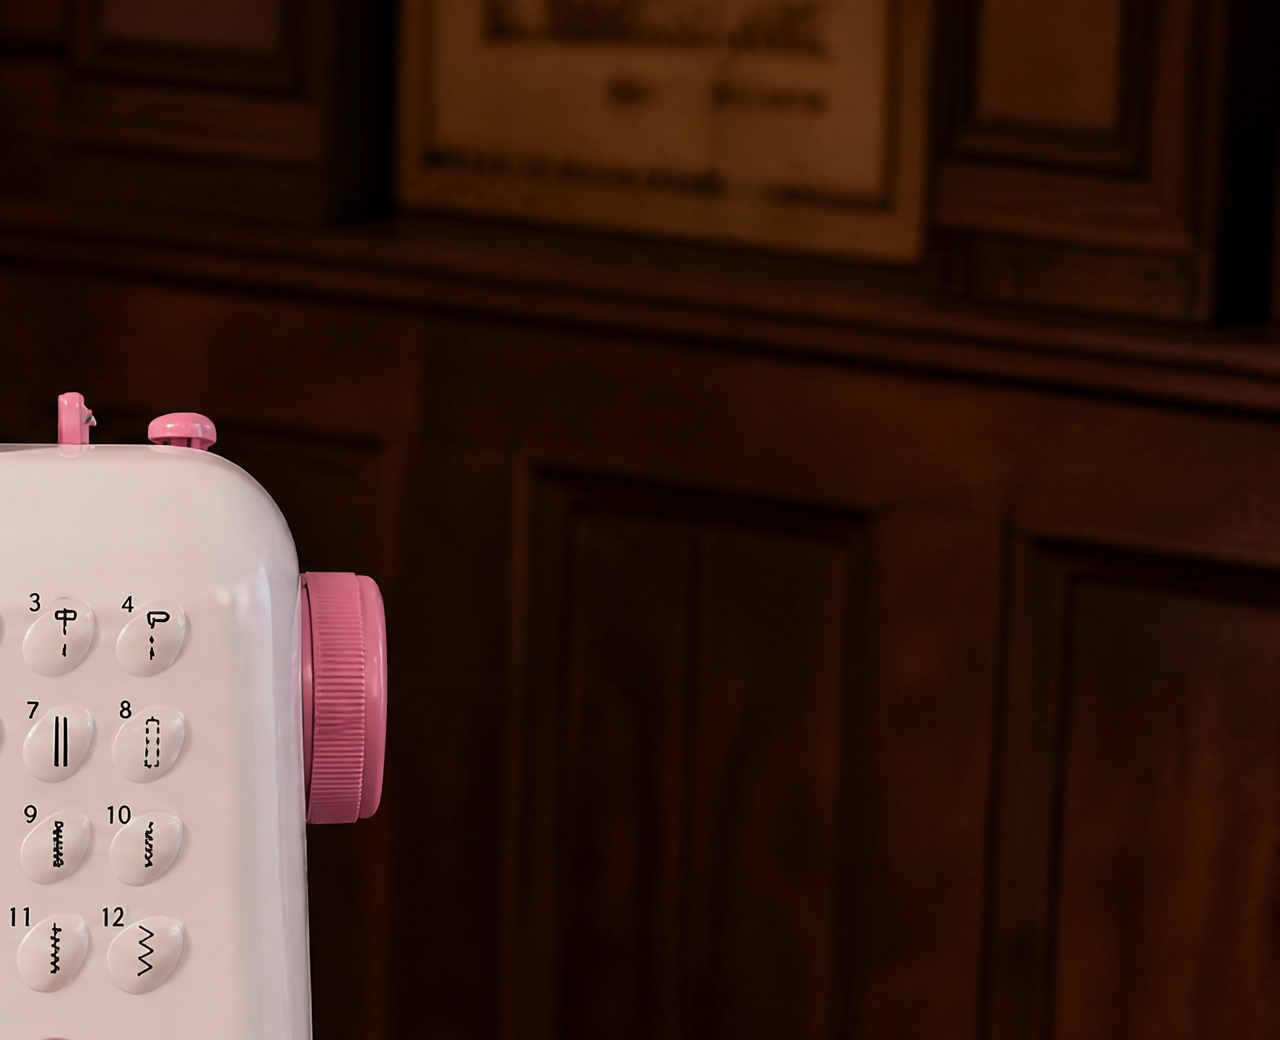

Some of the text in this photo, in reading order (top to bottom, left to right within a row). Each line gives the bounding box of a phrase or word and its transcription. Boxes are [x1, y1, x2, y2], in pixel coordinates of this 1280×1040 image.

[29, 592, 41, 612] 3
[121, 595, 135, 613] 4
[26, 700, 40, 720] 7
[119, 700, 132, 720] 8
[23, 804, 132, 825] 9 10
[10, 906, 125, 927] 11 12
